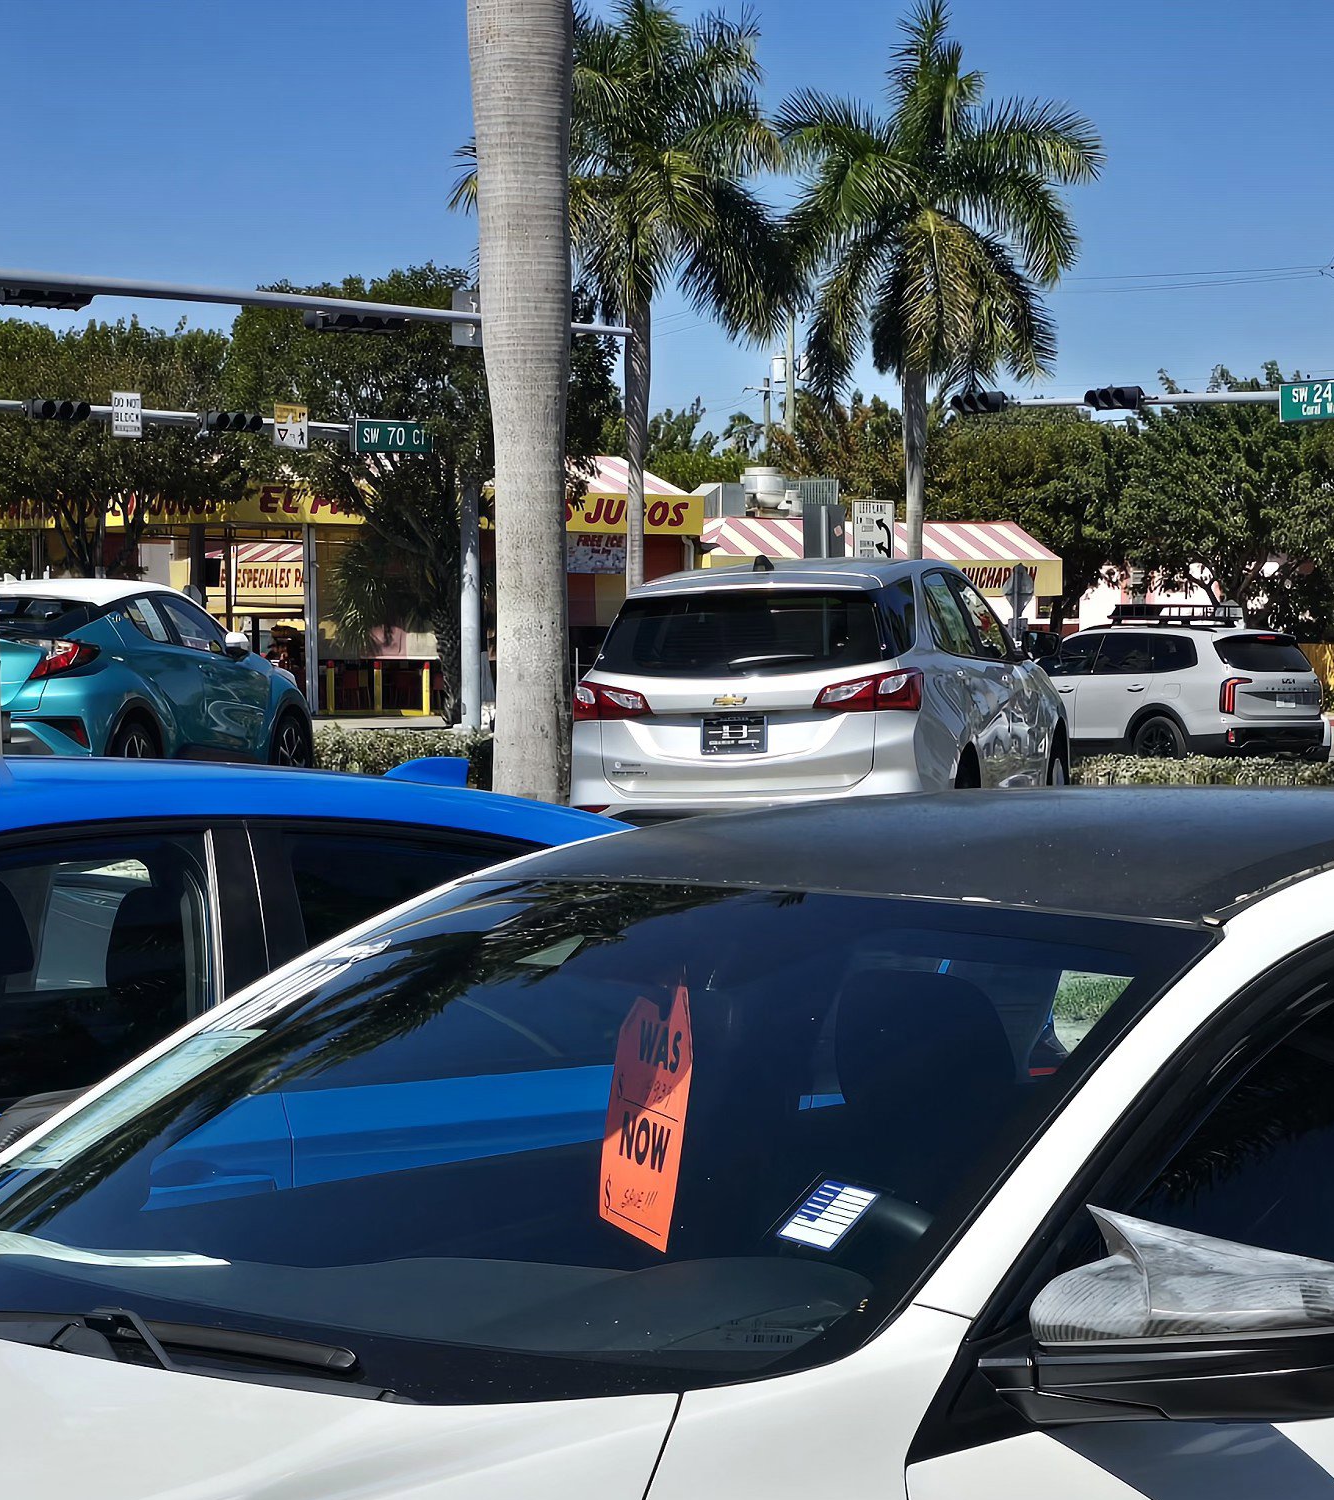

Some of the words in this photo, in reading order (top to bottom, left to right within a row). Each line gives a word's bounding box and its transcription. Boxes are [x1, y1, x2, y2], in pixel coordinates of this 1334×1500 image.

[1292, 387, 1308, 402] SW
[1313, 383, 1332, 403] 24
[363, 427, 379, 443] SW
[387, 427, 405, 446] 70
[584, 498, 689, 527] JUOS
[639, 1020, 682, 1073] WAS
[619, 1111, 671, 1173] NOW
